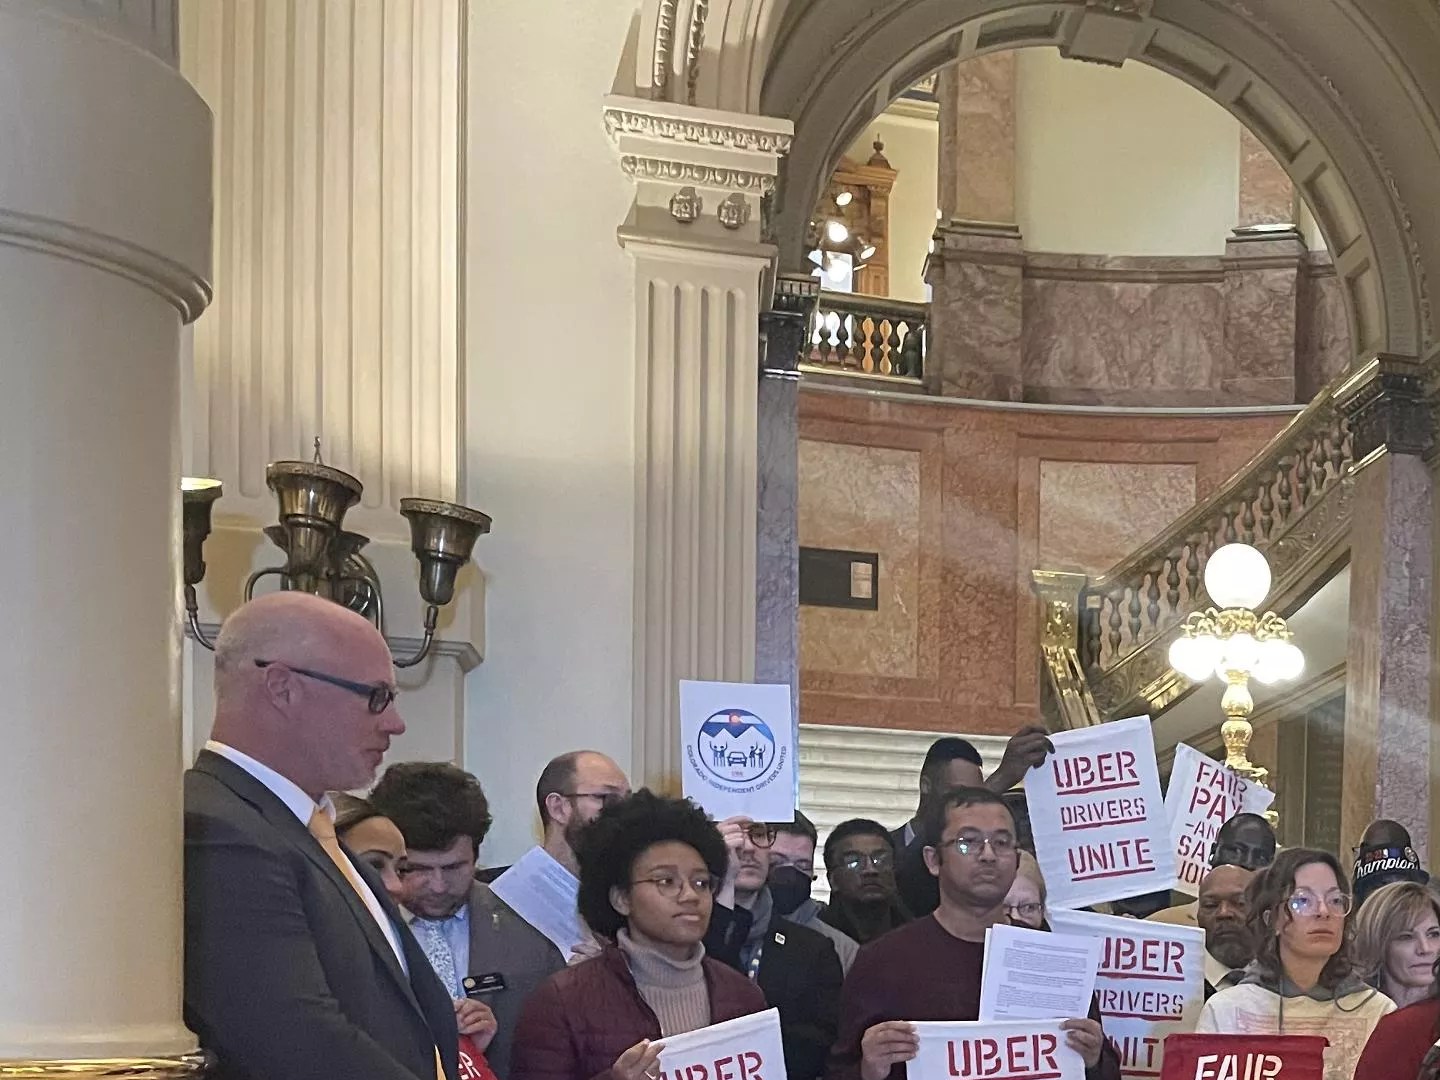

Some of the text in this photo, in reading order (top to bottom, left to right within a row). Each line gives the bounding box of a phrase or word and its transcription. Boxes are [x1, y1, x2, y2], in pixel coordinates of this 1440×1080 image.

[1052, 750, 1138, 788] UBER
[1196, 761, 1248, 802] FAIR
[1060, 797, 1146, 825] DRIVERS
[1068, 838, 1154, 874] UNITE
[1177, 834, 1206, 863] SA
[947, 1033, 1058, 1077] UBER
